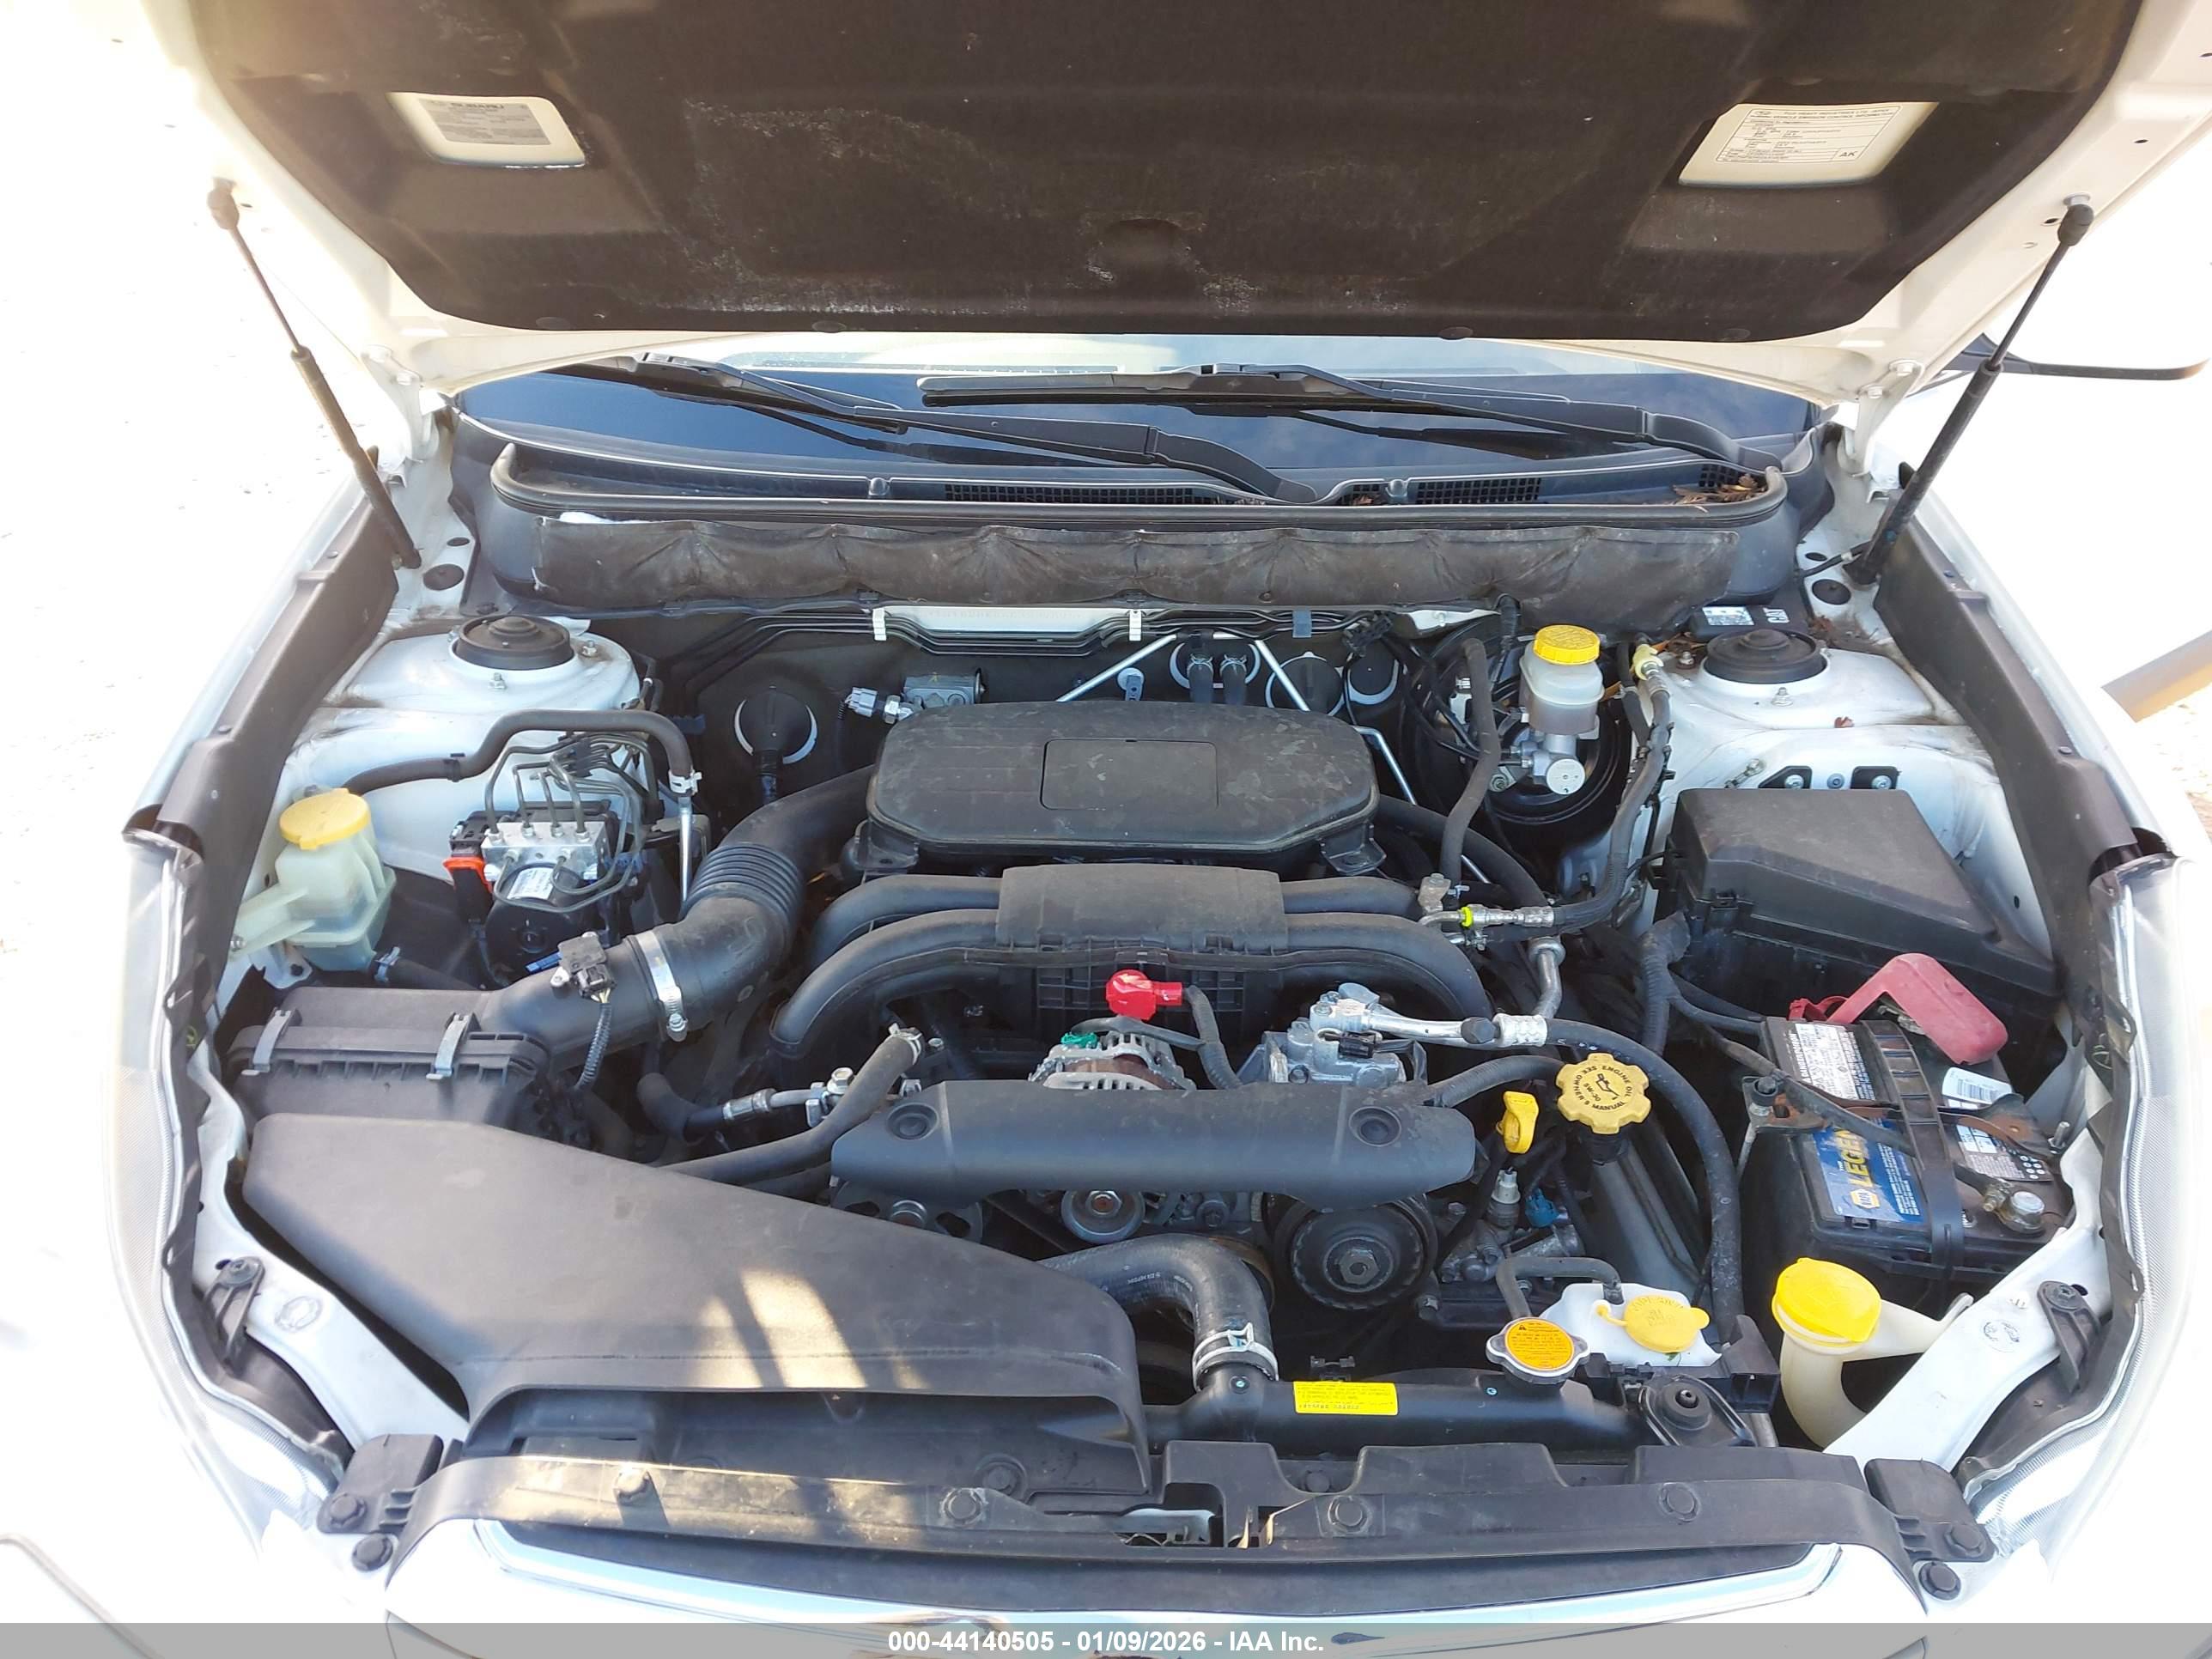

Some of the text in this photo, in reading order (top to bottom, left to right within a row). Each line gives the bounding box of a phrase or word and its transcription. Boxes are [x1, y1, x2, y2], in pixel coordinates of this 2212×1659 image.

[1582, 1065, 1598, 1075] SEE
[1591, 1100, 1627, 1111] MANUAL
[1583, 1082, 1601, 1102] 5W-30
[1601, 1065, 1633, 1097] ENGINE OIL
